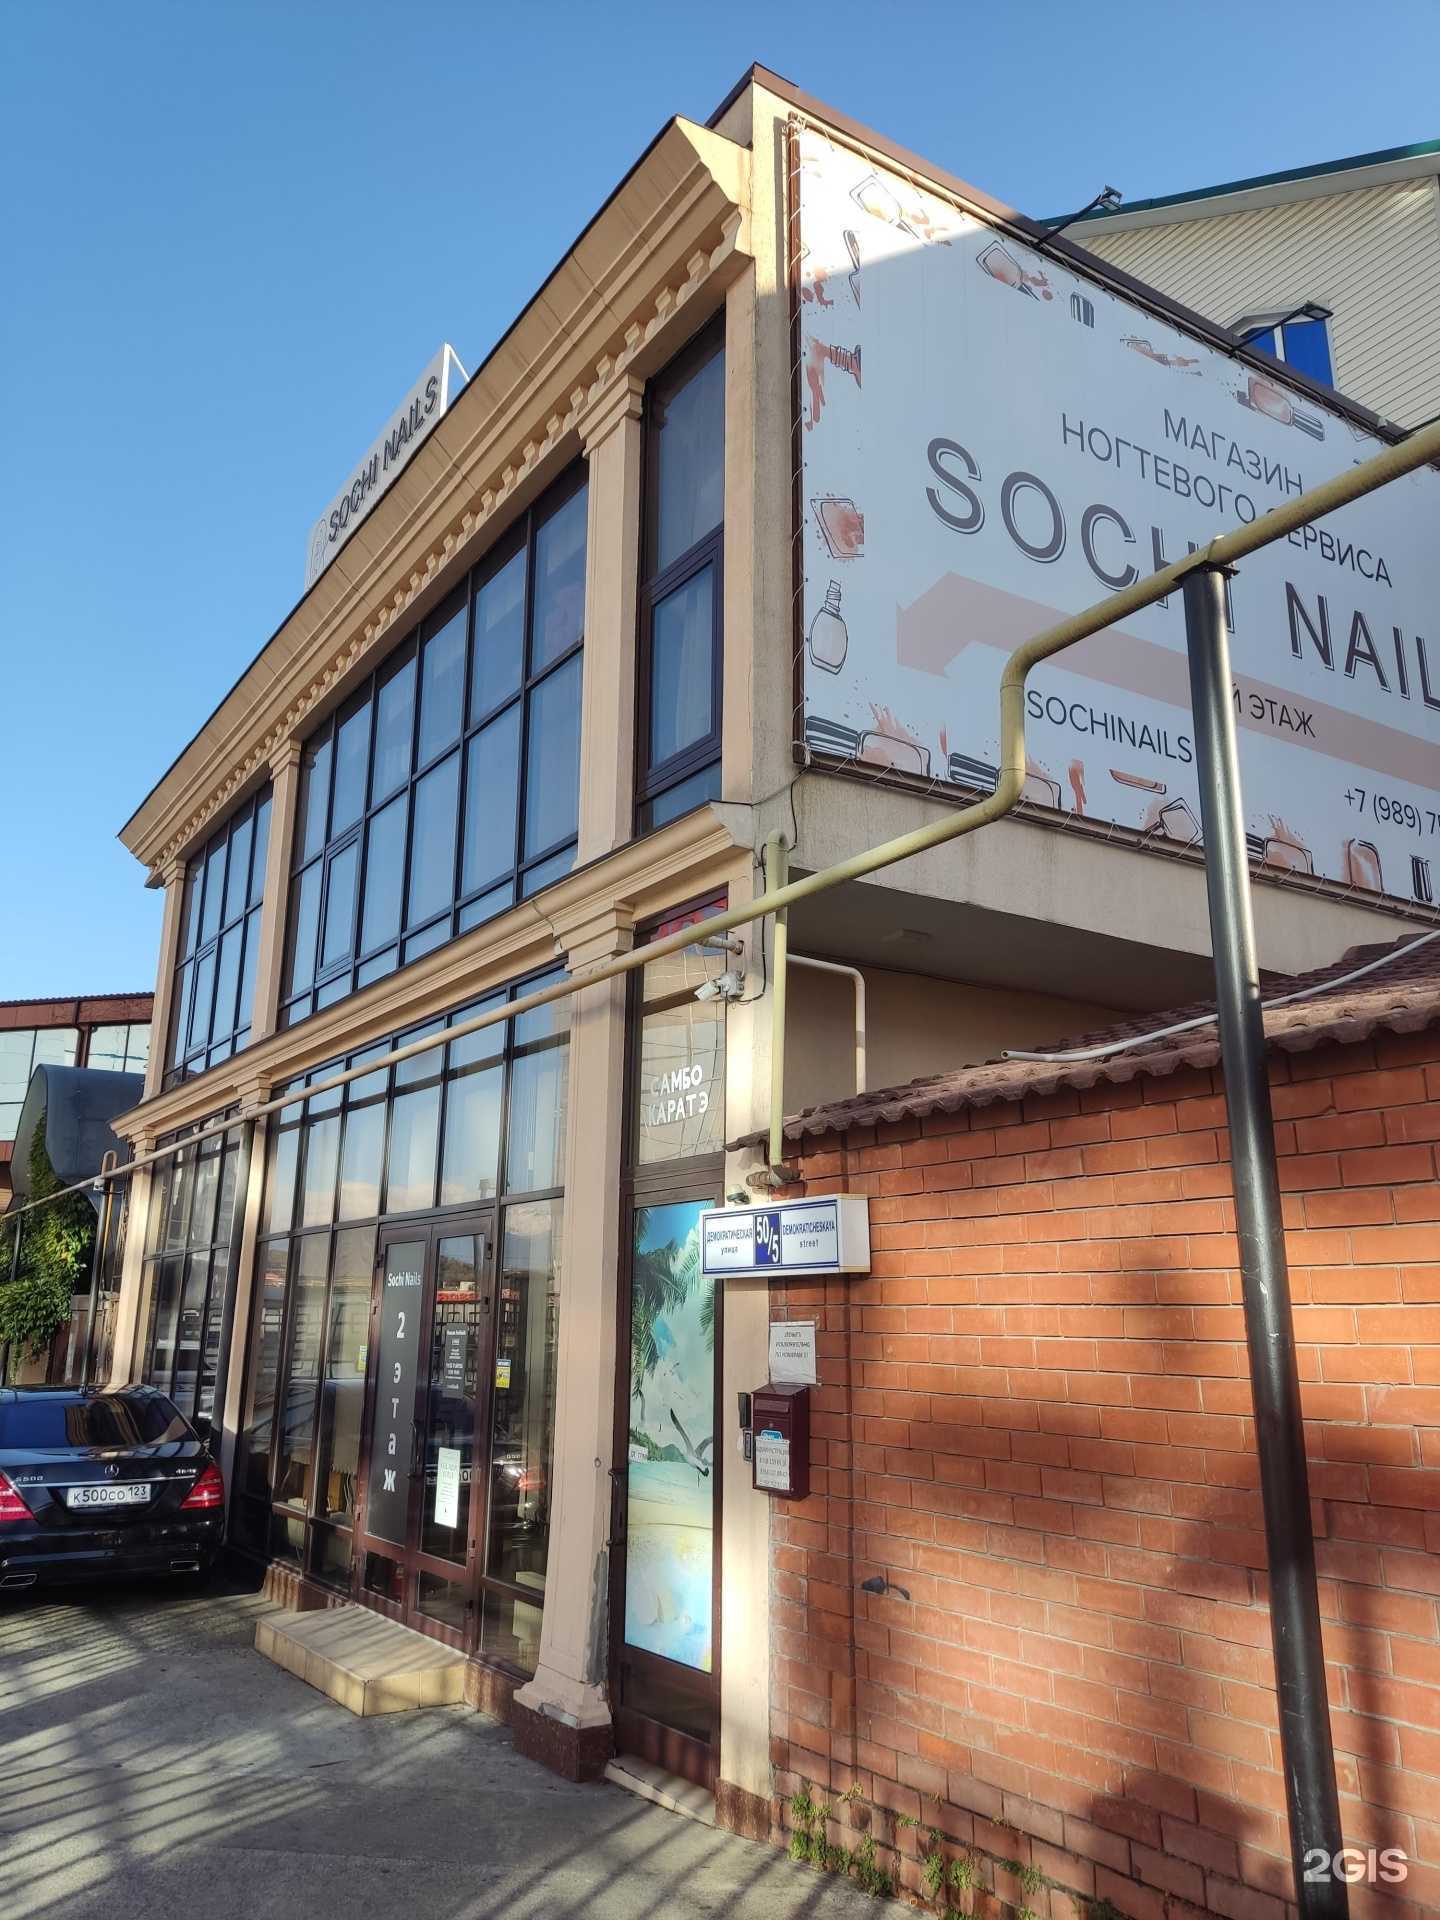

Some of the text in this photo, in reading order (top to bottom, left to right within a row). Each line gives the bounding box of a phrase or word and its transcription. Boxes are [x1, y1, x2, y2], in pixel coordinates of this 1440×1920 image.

[328, 375, 438, 542] SOCHI NAILS
[1164, 408, 1303, 496] МАГАЗИН
[1062, 413, 1392, 588] НОГТЕВОГО ЕРВИСА
[1027, 690, 1193, 763] SOCHINAILS
[1249, 694, 1316, 738] ЭТАЖ
[1344, 788, 1440, 837] +7 (989) 7
[651, 1064, 703, 1096] САМБО
[649, 1091, 709, 1126] КАРАТЭ
[388, 1272, 421, 1287] Sochi Nails
[396, 1311, 406, 1339] 2
